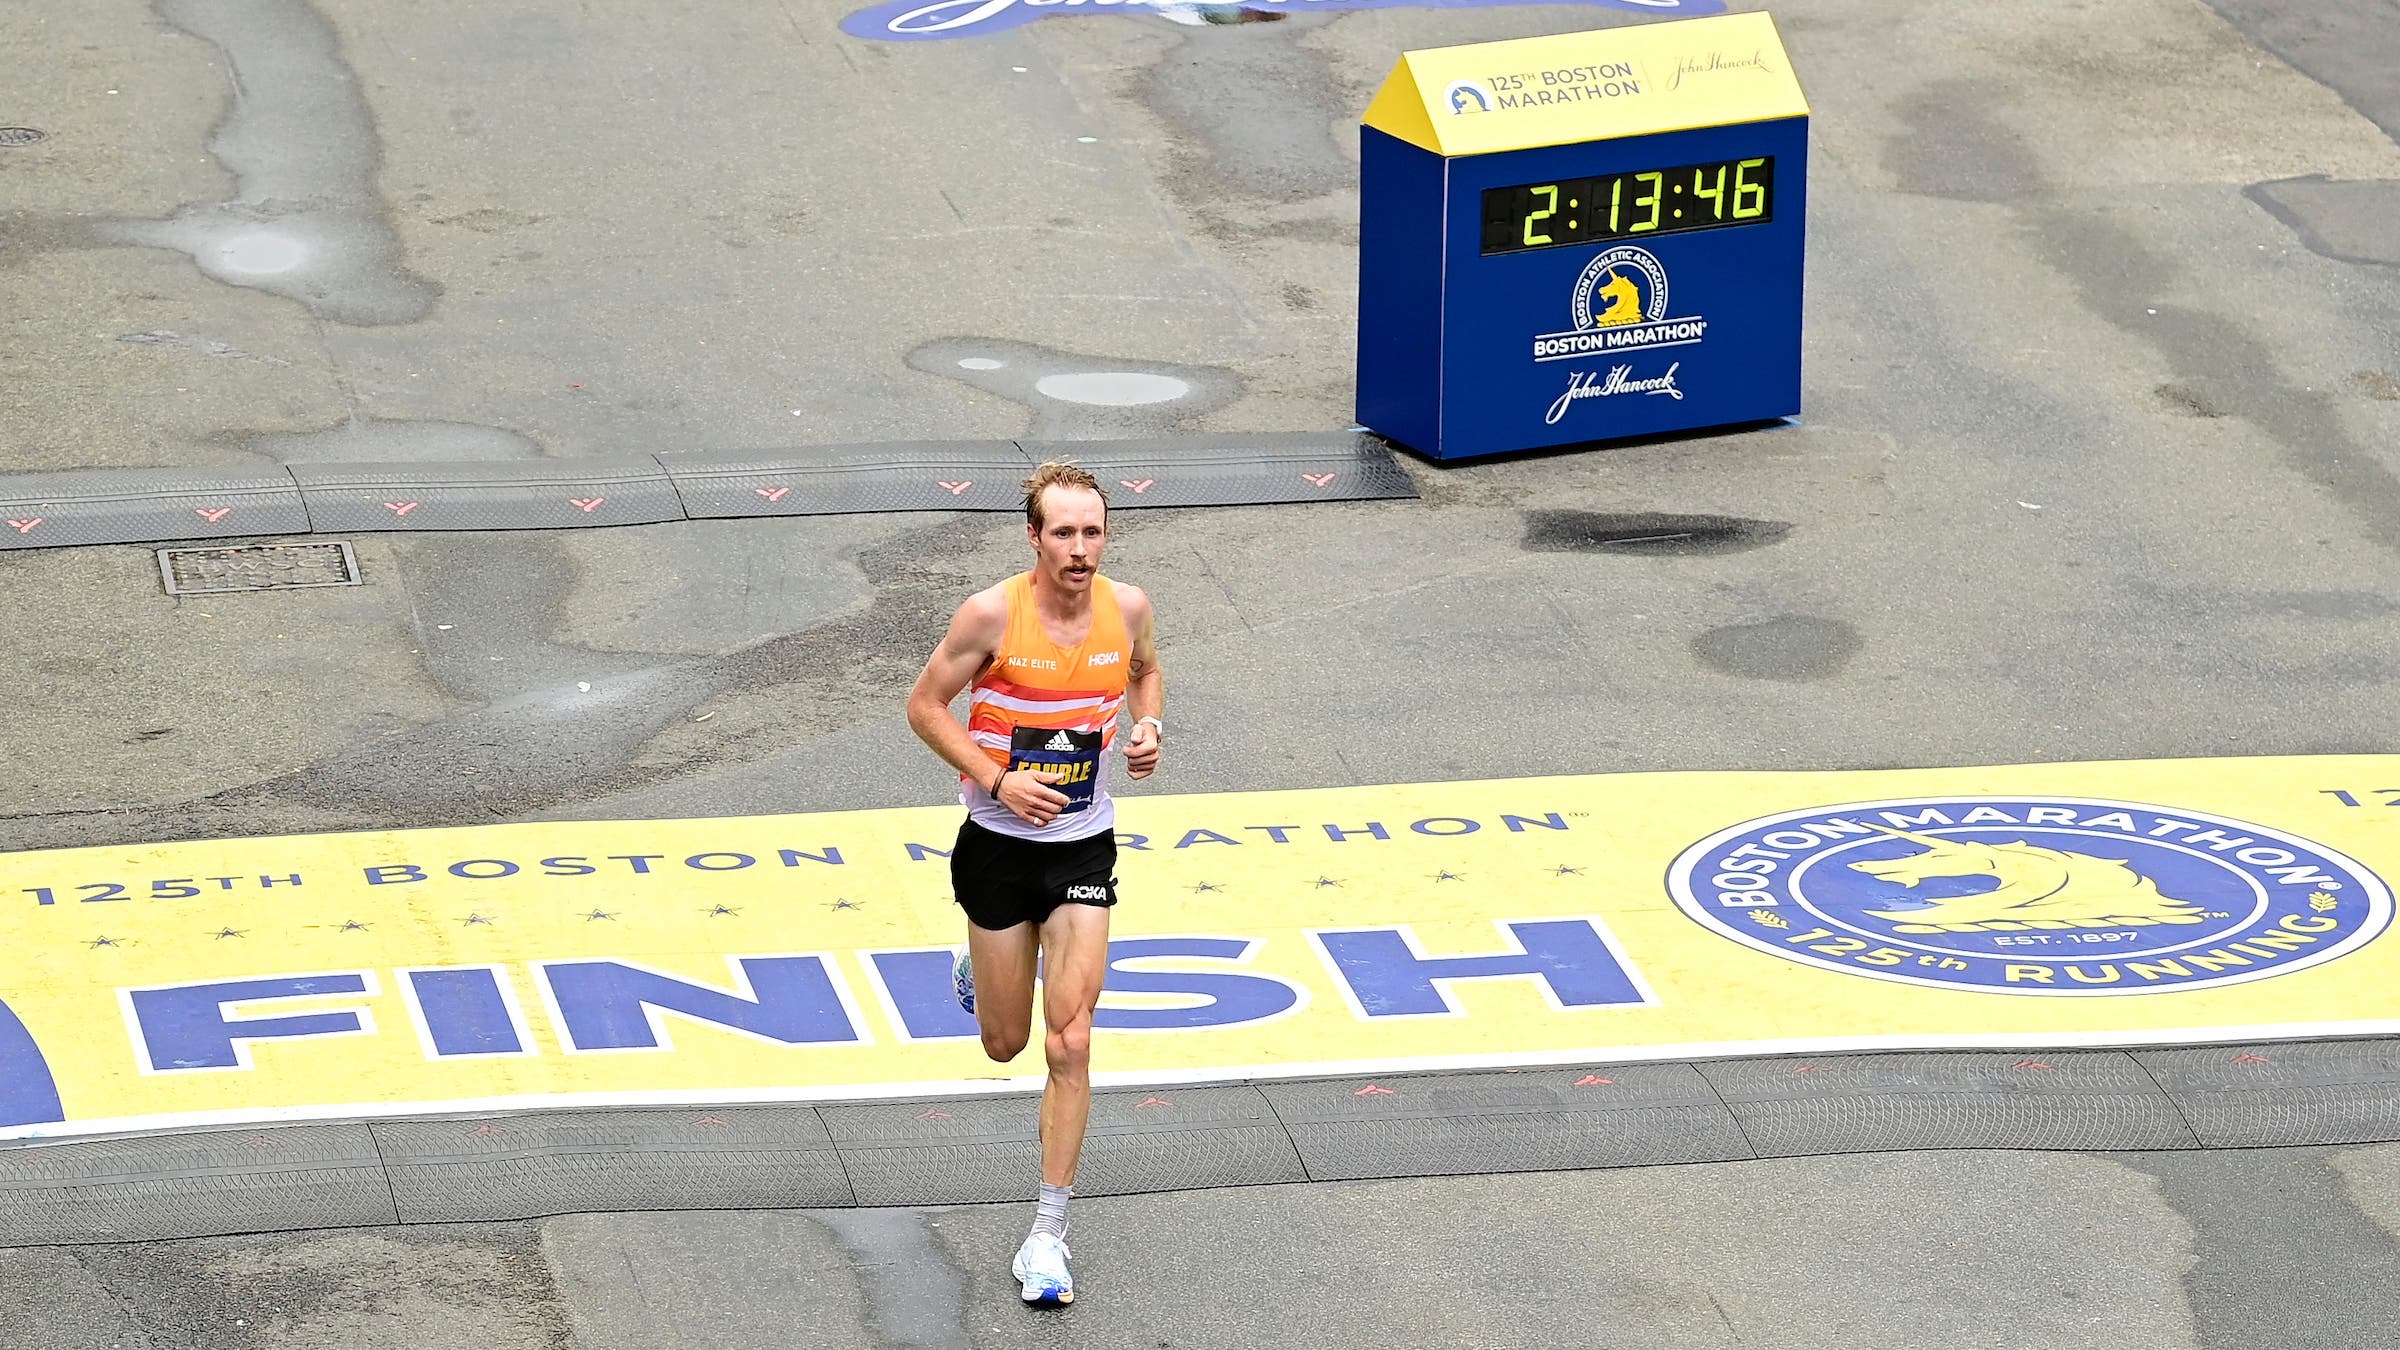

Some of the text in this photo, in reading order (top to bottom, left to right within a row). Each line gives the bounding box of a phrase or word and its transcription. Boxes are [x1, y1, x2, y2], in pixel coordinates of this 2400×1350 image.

[1487, 61, 1634, 92] 125TH BOSTON
[1665, 49, 1774, 91] John Hancock
[1496, 79, 1641, 110] MARATHON
[1523, 158, 1765, 246] 2:13:46
[1575, 250, 1665, 326] BOSTON ATHLETIC ASSOCIATION
[1533, 321, 1703, 357] BOSTON MARATHON
[1545, 361, 1684, 425] John Hancock
[1008, 656, 1057, 671] NAZ ELITE
[1087, 651, 1120, 668] HOKA
[1044, 743, 1075, 752] adidas
[21, 811, 1569, 906] 125TH BOSTON MRATHON
[1711, 817, 1873, 908] BOSTON
[1067, 885, 1107, 901] HOKA
[1784, 913, 2339, 984] 125th RUNNING
[1993, 931, 2138, 947] EST. 1897
[128, 918, 1646, 1072] FINISH
